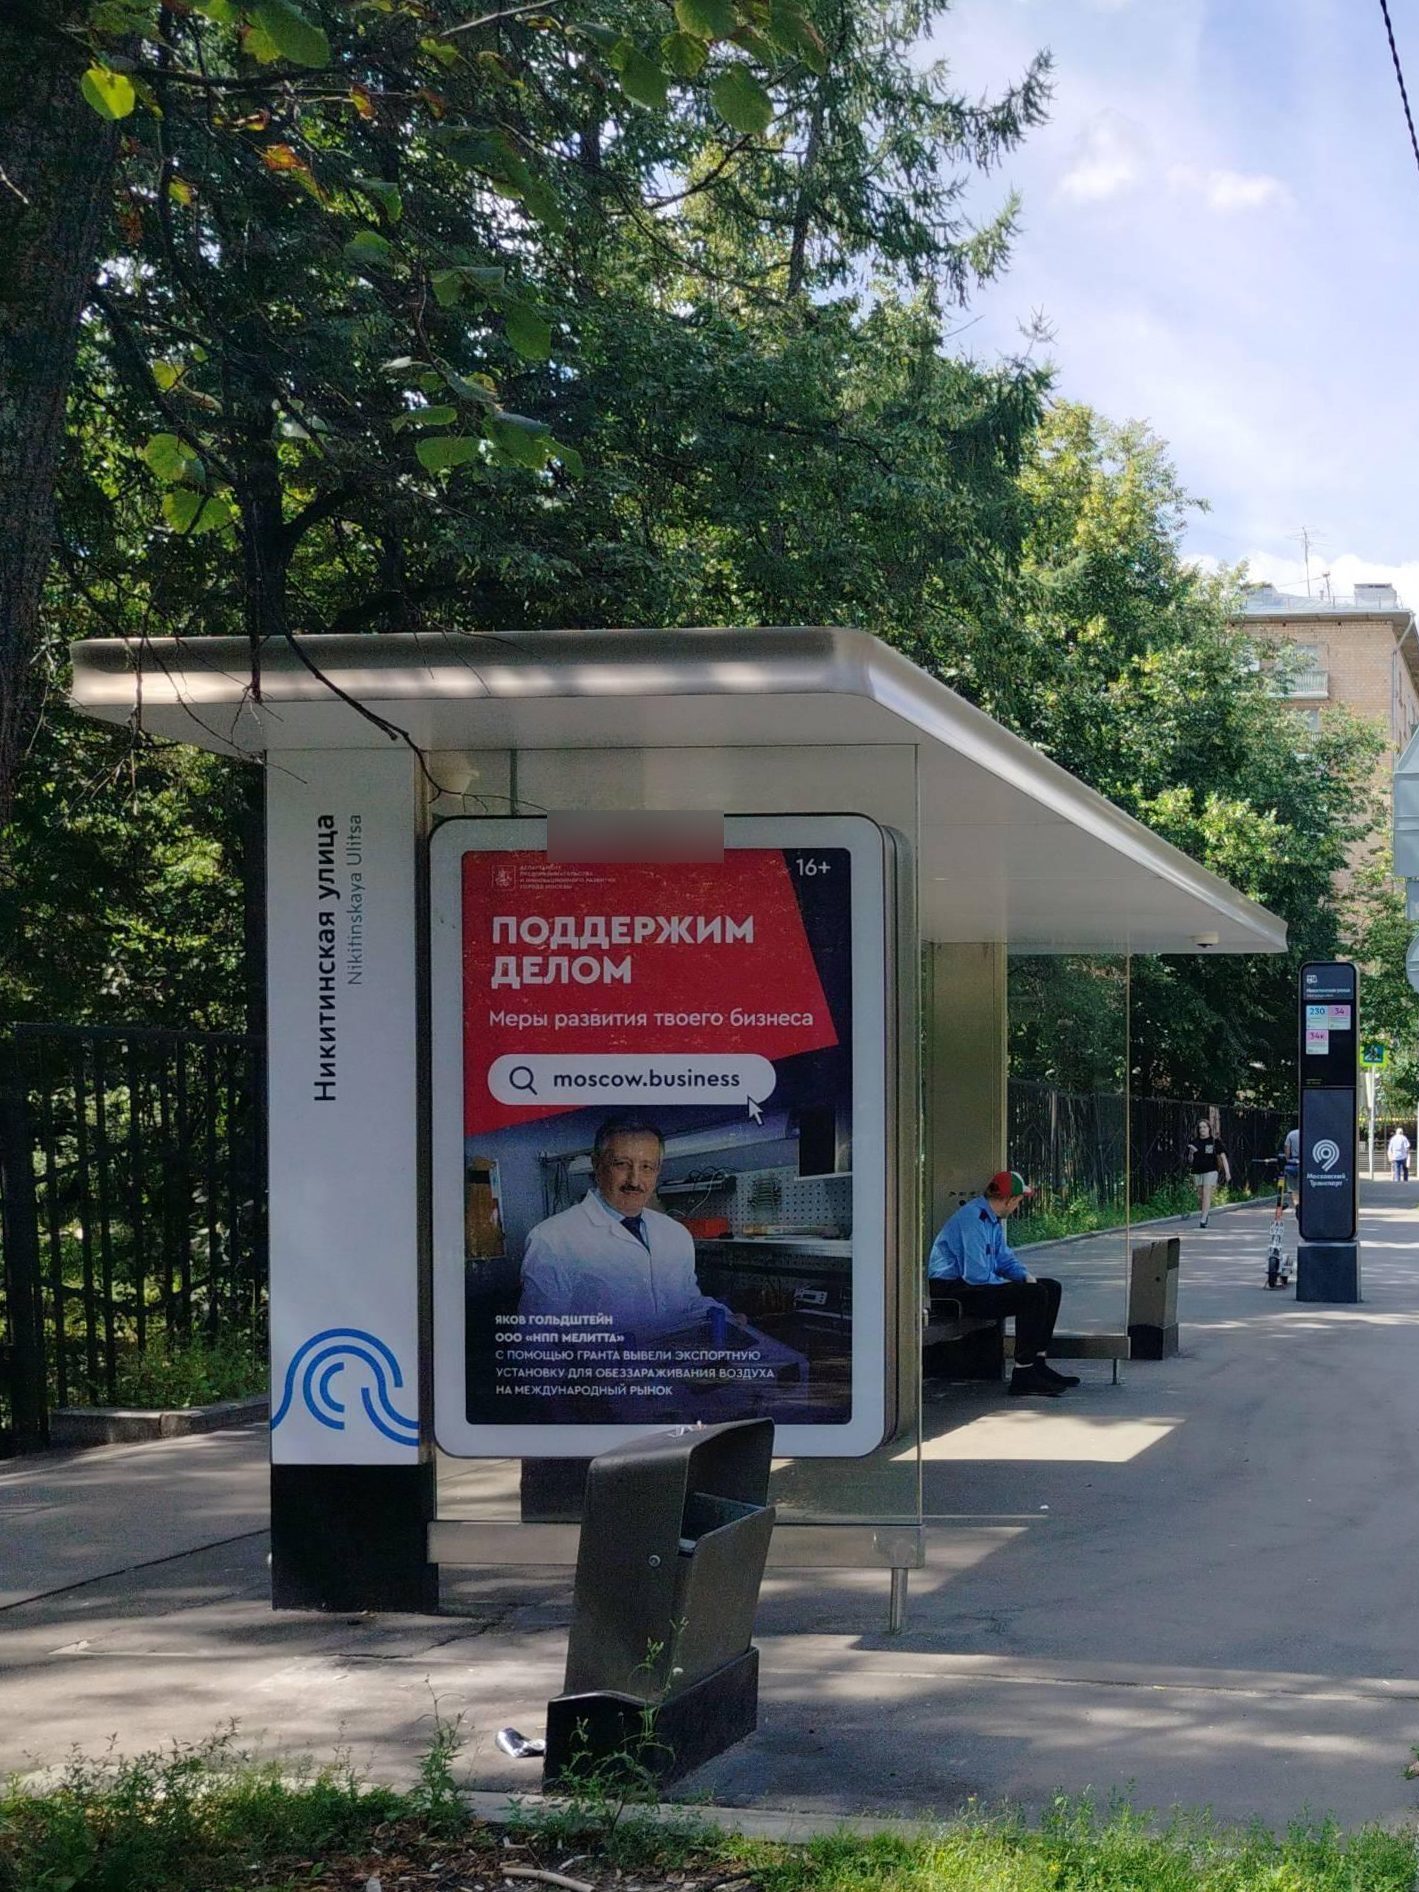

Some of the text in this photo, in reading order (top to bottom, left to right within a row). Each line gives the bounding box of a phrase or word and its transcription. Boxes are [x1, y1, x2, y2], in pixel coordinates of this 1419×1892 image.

[796, 859, 832, 877] 16+
[346, 814, 366, 985] Nikitinskaya Ulitsa
[492, 915, 754, 949] ПОДДЕРЖИМ
[314, 814, 341, 1101] Никитинская улица
[491, 956, 632, 989] ДЕЛОМ
[489, 1007, 813, 1029] Меры развития твоего бизнеса
[1309, 1007, 1325, 1015] 230
[1335, 1007, 1345, 1015] 34
[554, 1069, 740, 1087] moscow.business
[495, 1313, 613, 1327] ЯКОВ ГОЛЬДШТЕЙН
[495, 1333, 624, 1342] ООО «НПП МЕЛИТТА»
[495, 1351, 761, 1362] С ПОМОЩЬЮ ГРАНТА ВЫВЕЛИ ЭКСПОРТНУЮ
[496, 1368, 775, 1379] УСТАНОВКУ ДЛЯ ОБЕЗЗАРАЖИВАНИЯ ВОЗДУХА
[496, 1383, 673, 1396] НА МЕЖДУНАРОДНЫЙ РЫНОК
